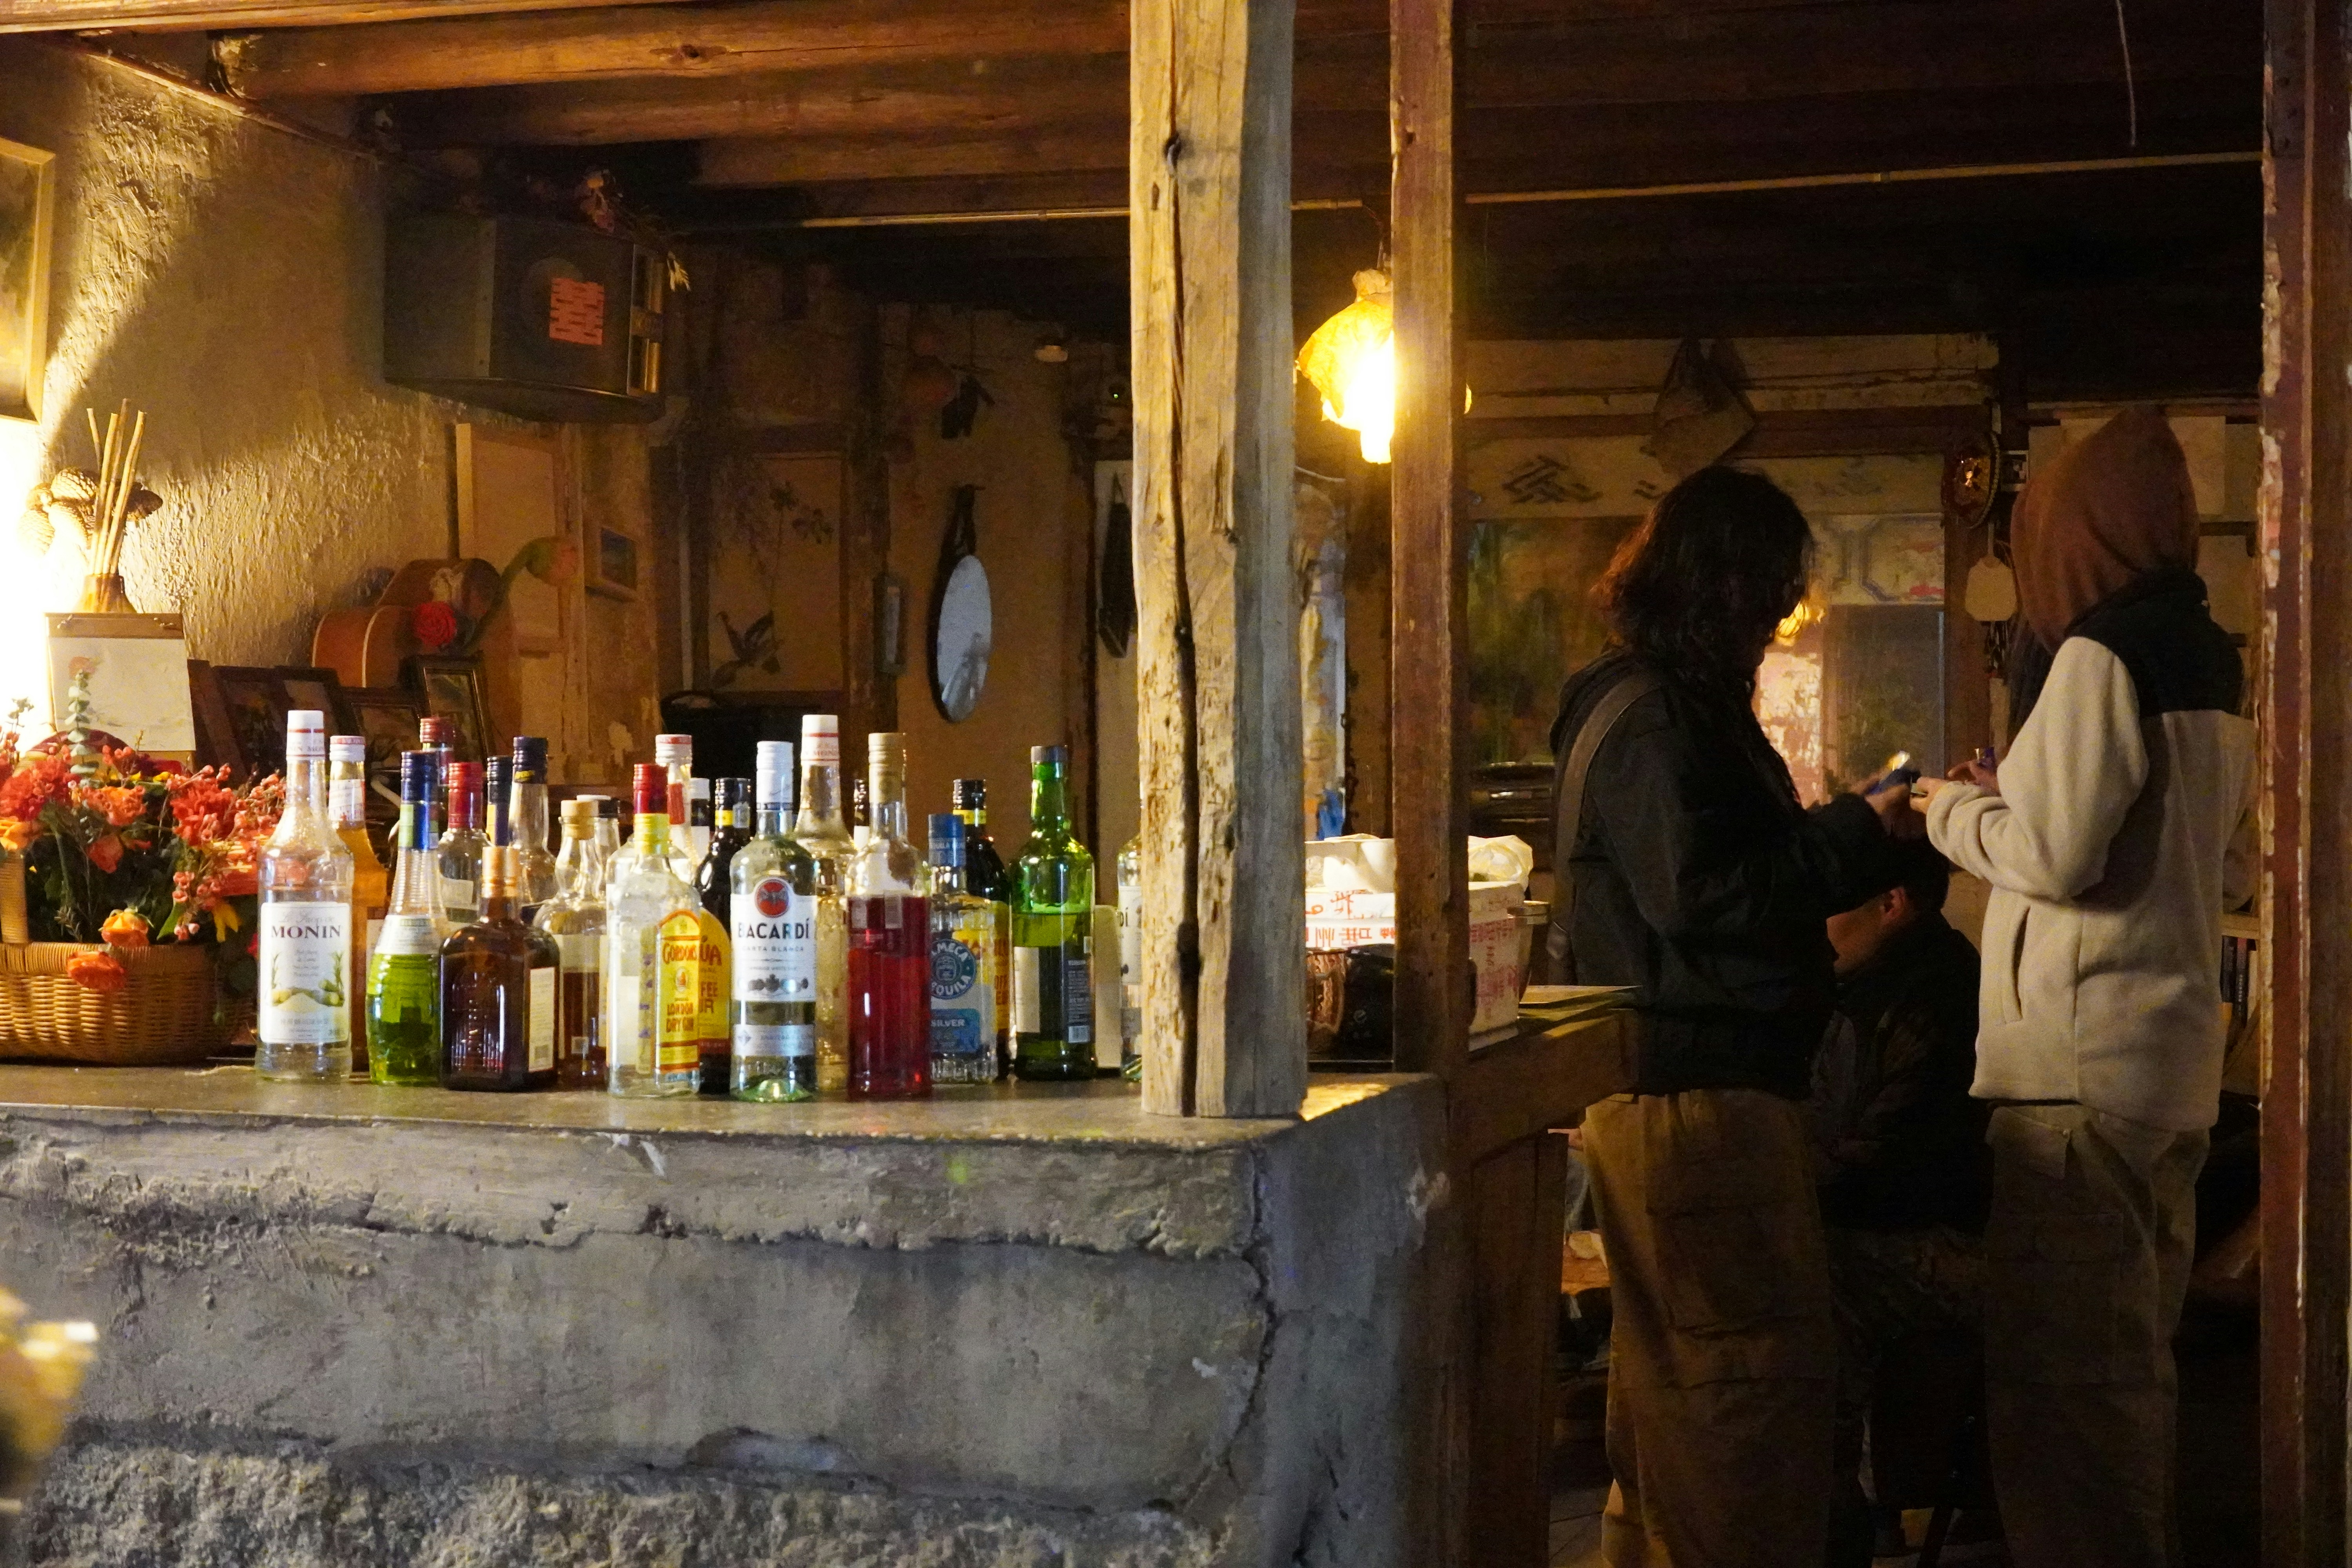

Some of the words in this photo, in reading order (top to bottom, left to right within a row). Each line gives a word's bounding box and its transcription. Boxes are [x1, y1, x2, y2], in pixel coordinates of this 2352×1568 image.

[271, 925, 341, 939] MONIN
[738, 918, 810, 939] BACARDÍ
[667, 1003, 694, 1016] LONDON
